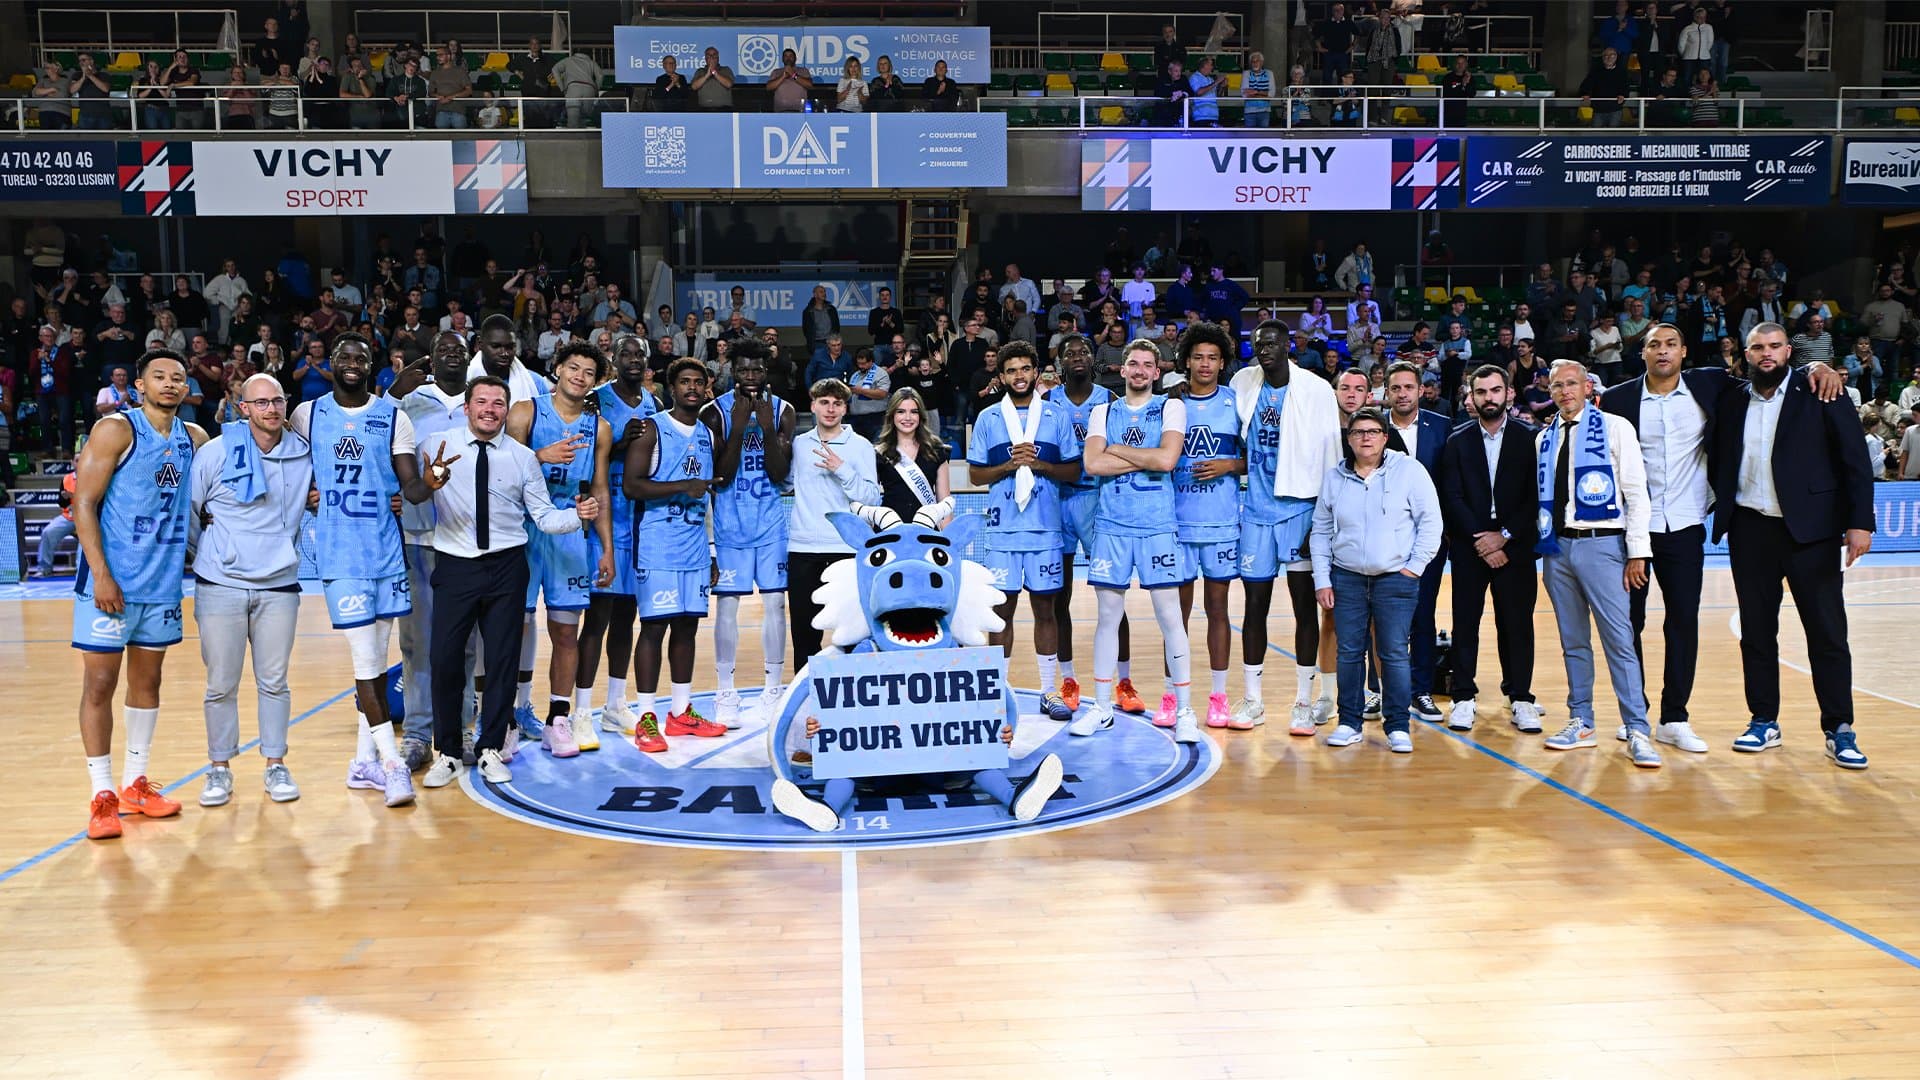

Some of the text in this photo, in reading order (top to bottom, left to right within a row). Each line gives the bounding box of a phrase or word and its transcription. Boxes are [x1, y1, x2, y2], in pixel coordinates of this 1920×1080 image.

[902, 34, 959, 44] MONTAGE
[650, 40, 697, 56] Exigez
[783, 34, 870, 65] MDS
[902, 49, 976, 61] DÉMONTAGE
[630, 55, 706, 69] la séurité
[12, 152, 31, 168] 70
[34, 152, 51, 168] 42
[55, 152, 72, 168] 40
[76, 152, 93, 168] 46
[1208, 146, 1337, 173] VICHY
[1564, 145, 1631, 159] CARROSSERIE
[1642, 145, 1700, 160] MECANIQUE
[1710, 144, 1751, 158] VITRAGE
[253, 148, 392, 177] VICHY
[1483, 161, 1545, 176] CAR auto
[1755, 159, 1816, 174] CAR auto
[2, 174, 37, 186] TUREAU
[46, 174, 75, 186] 03230
[78, 173, 115, 185] LUSIGNY
[1565, 171, 1573, 183] ZI
[1576, 171, 1626, 183] VICHY-RHUE
[1636, 171, 1676, 182] Passage
[1679, 169, 1690, 181] de
[1693, 169, 1741, 181] l'industrie
[286, 190, 368, 208] SPORT
[1236, 186, 1311, 203] SPORT
[1597, 184, 1710, 197] 03300 CREUZIER LE VIEUX
[688, 289, 795, 311] TRIUNE
[1257, 429, 1280, 448] 22
[234, 445, 246, 470] 7
[744, 455, 765, 472] 26
[335, 464, 362, 485] 77
[548, 466, 569, 486] 21
[1178, 484, 1216, 493] VICHY
[160, 493, 174, 513] 7
[814, 669, 1001, 709] VICTOIRE
[817, 719, 1002, 753] POUR VICHY
